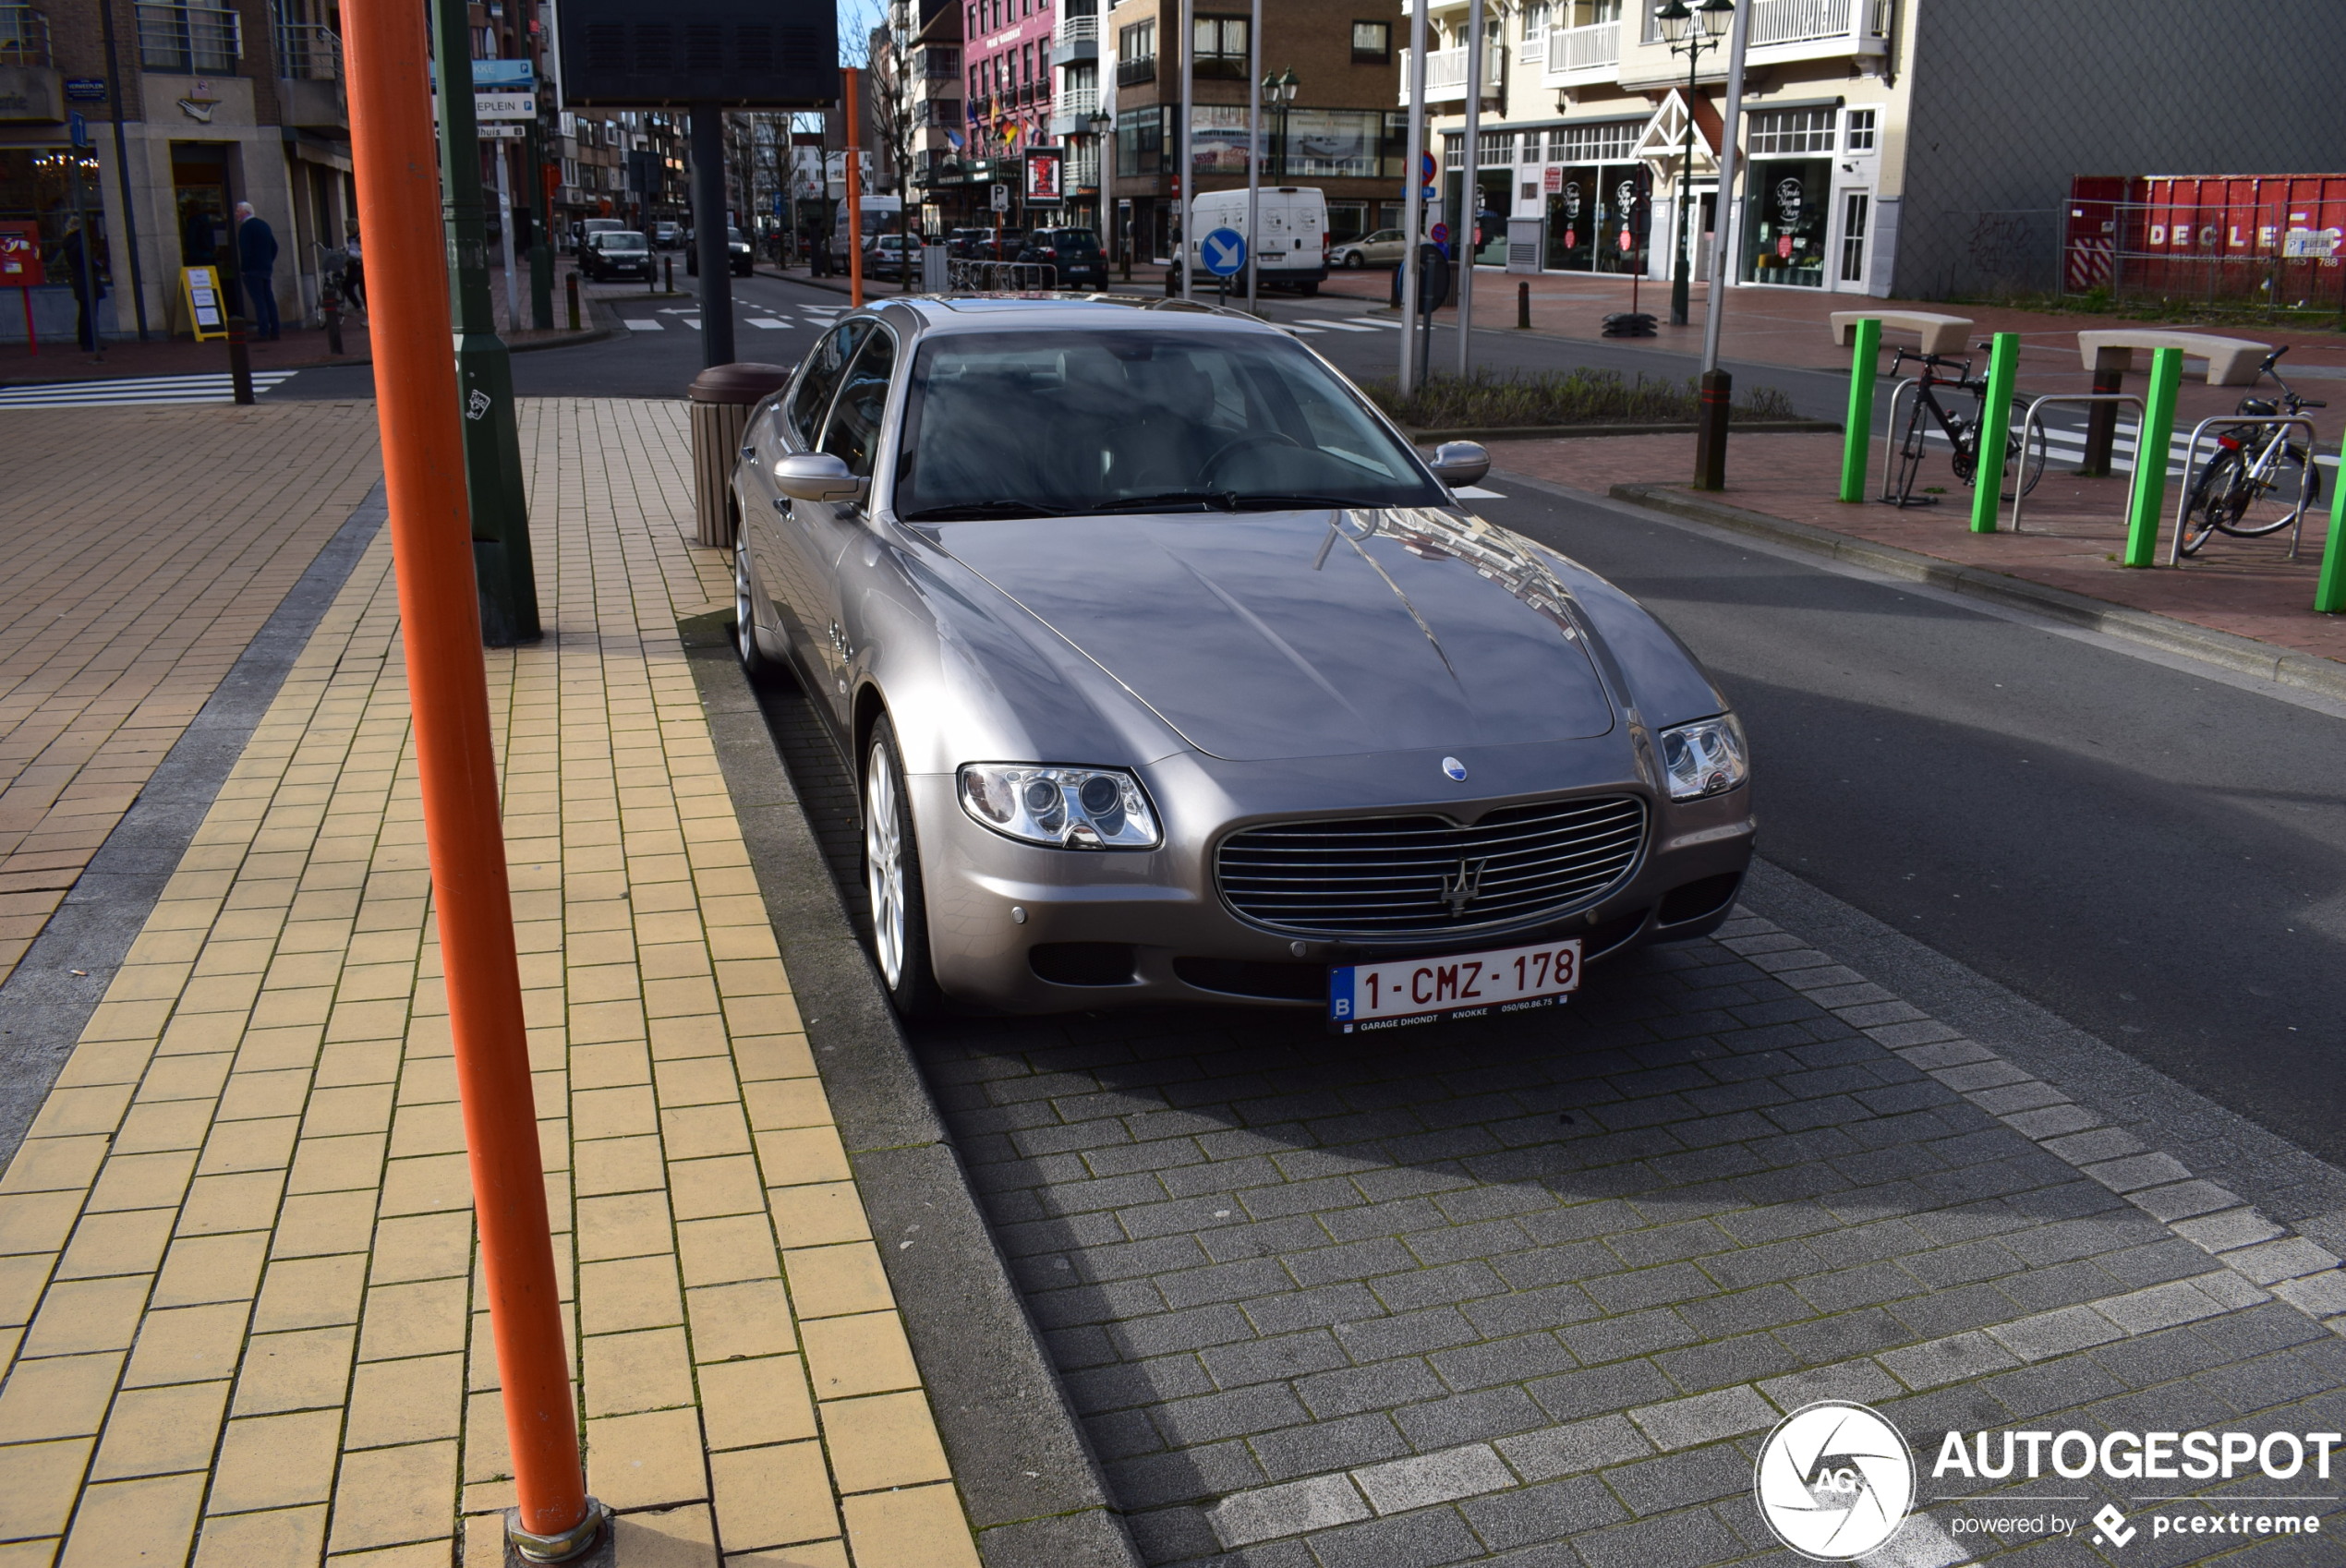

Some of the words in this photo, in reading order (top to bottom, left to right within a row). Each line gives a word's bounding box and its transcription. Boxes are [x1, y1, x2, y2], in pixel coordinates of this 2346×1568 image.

[994, 187, 1004, 200] P
[2318, 257, 2338, 267] 788
[1365, 948, 1574, 1009] 1-CMZ-178
[1336, 998, 1350, 1016] B
[1360, 1019, 1398, 1031] GARAGE
[1400, 1015, 1438, 1027] DHONDT
[1452, 1007, 1488, 1019] KNOKKE
[1501, 998, 1553, 1013] 050/60.86.75
